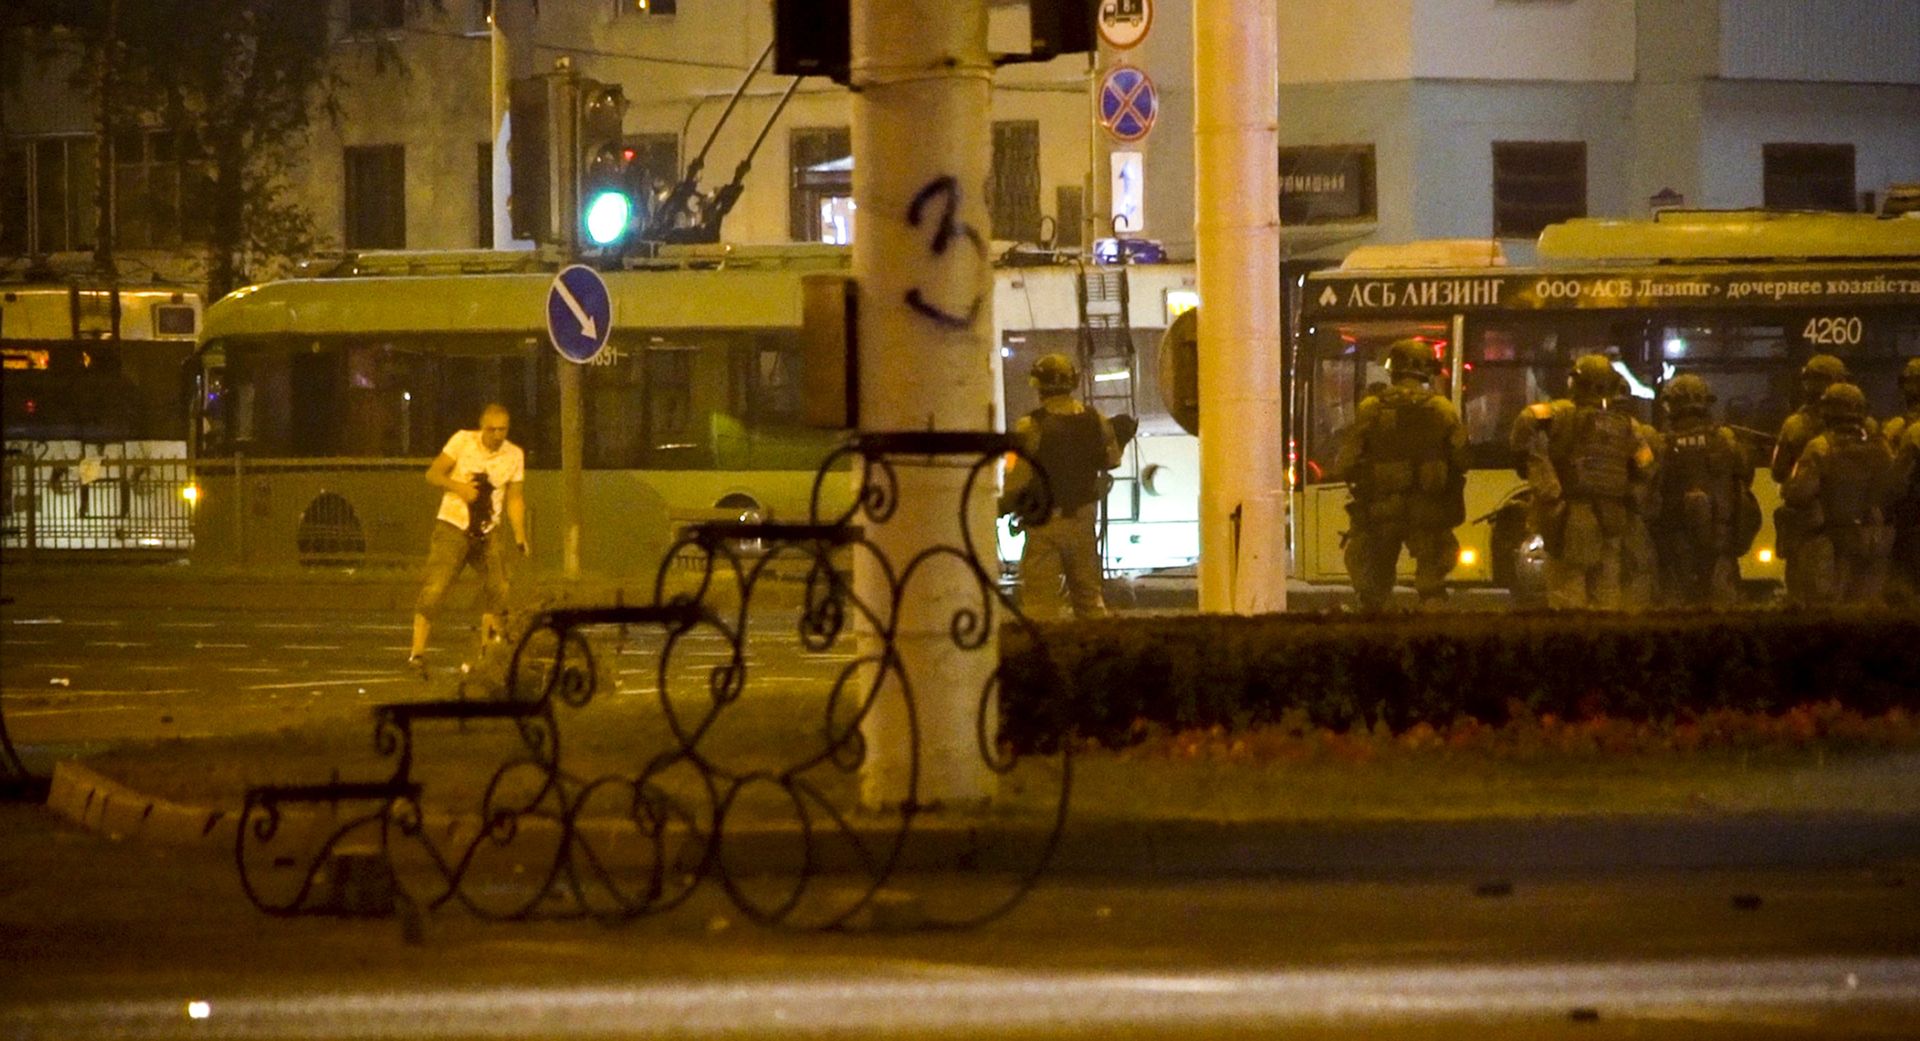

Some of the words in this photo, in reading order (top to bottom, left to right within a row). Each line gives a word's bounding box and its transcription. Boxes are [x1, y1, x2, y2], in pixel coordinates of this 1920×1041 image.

[1347, 281, 1396, 308] АСБ
[1401, 279, 1505, 306] ЛИЗИНГ
[1535, 280, 1581, 299] ООО
[1726, 278, 1822, 299] дочернее
[1802, 316, 1862, 345] 4260
